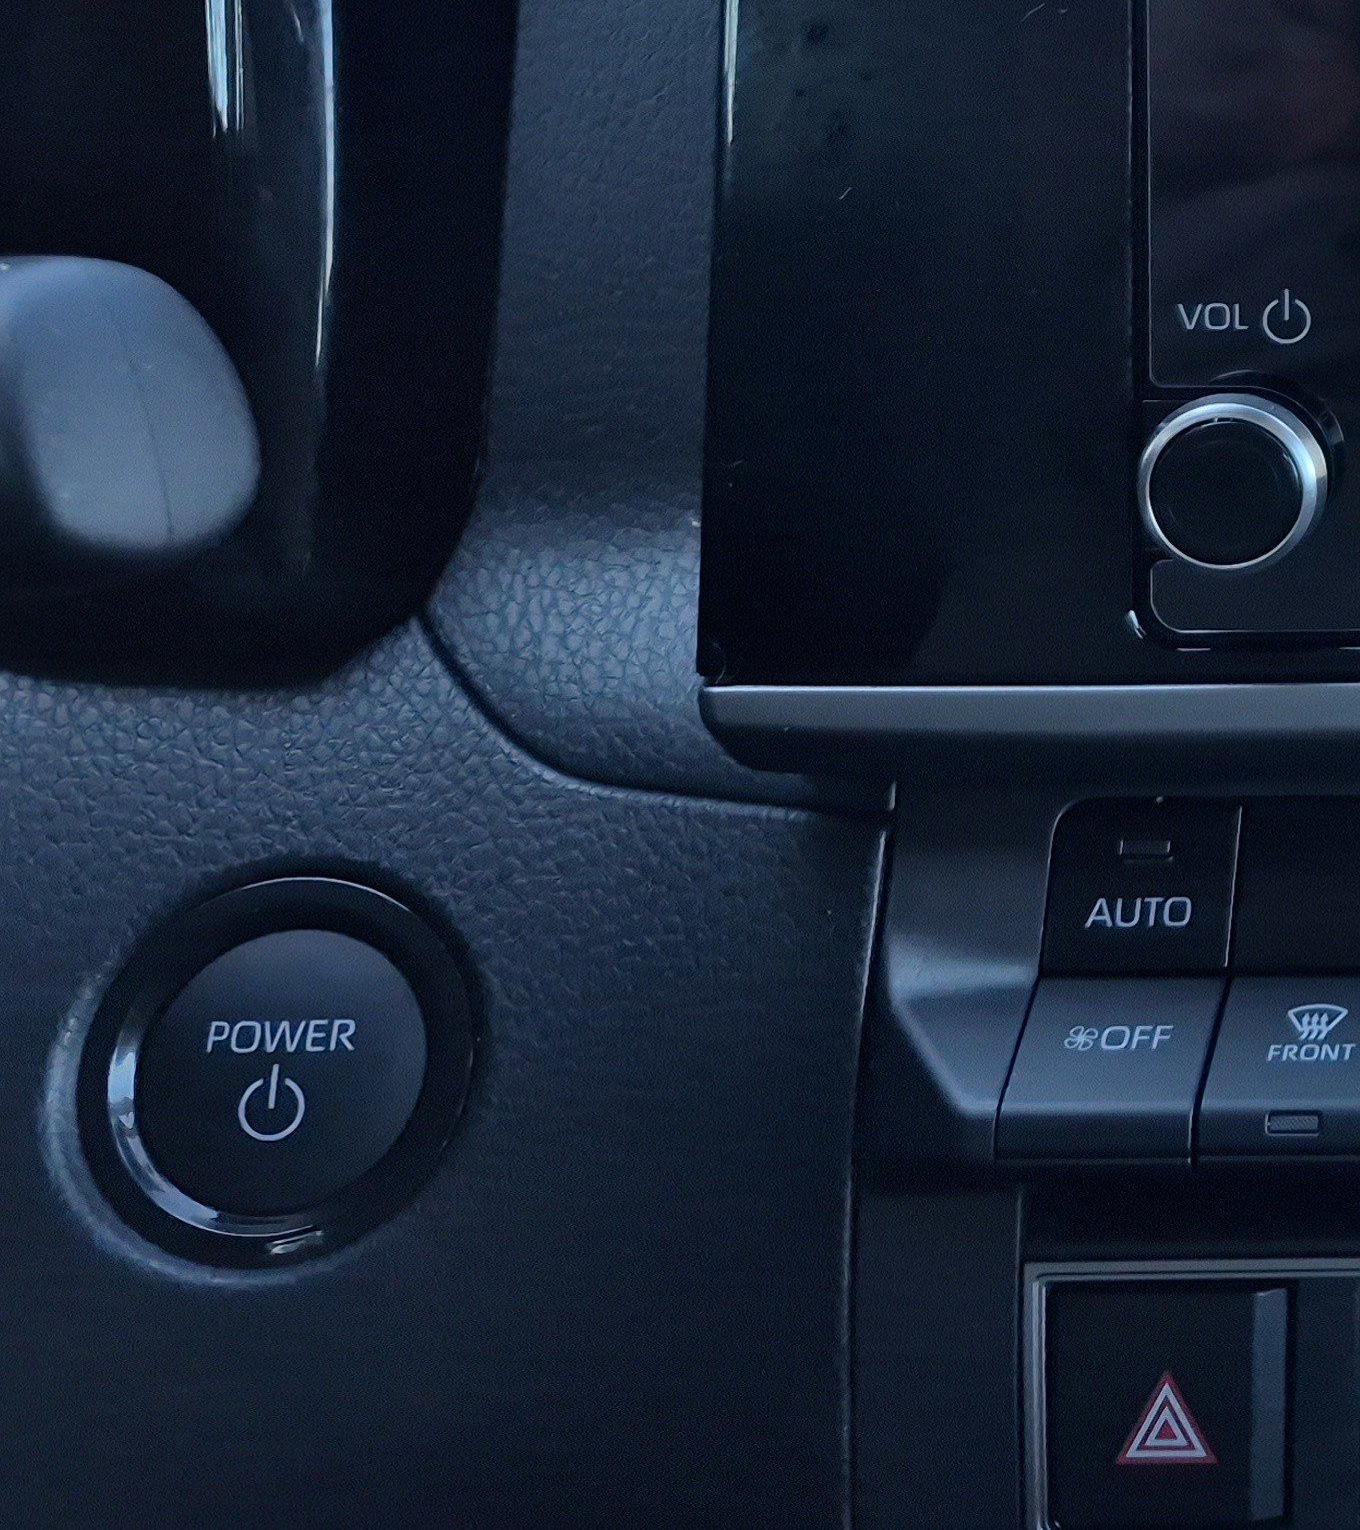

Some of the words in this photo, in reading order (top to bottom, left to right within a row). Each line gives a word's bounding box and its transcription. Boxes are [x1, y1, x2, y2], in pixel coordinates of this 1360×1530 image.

[1177, 302, 1249, 330] VOL
[1085, 896, 1192, 929] AUTO
[206, 1018, 357, 1054] POWER
[1100, 1024, 1174, 1051] OFF
[1266, 1042, 1356, 1062] FRONT
